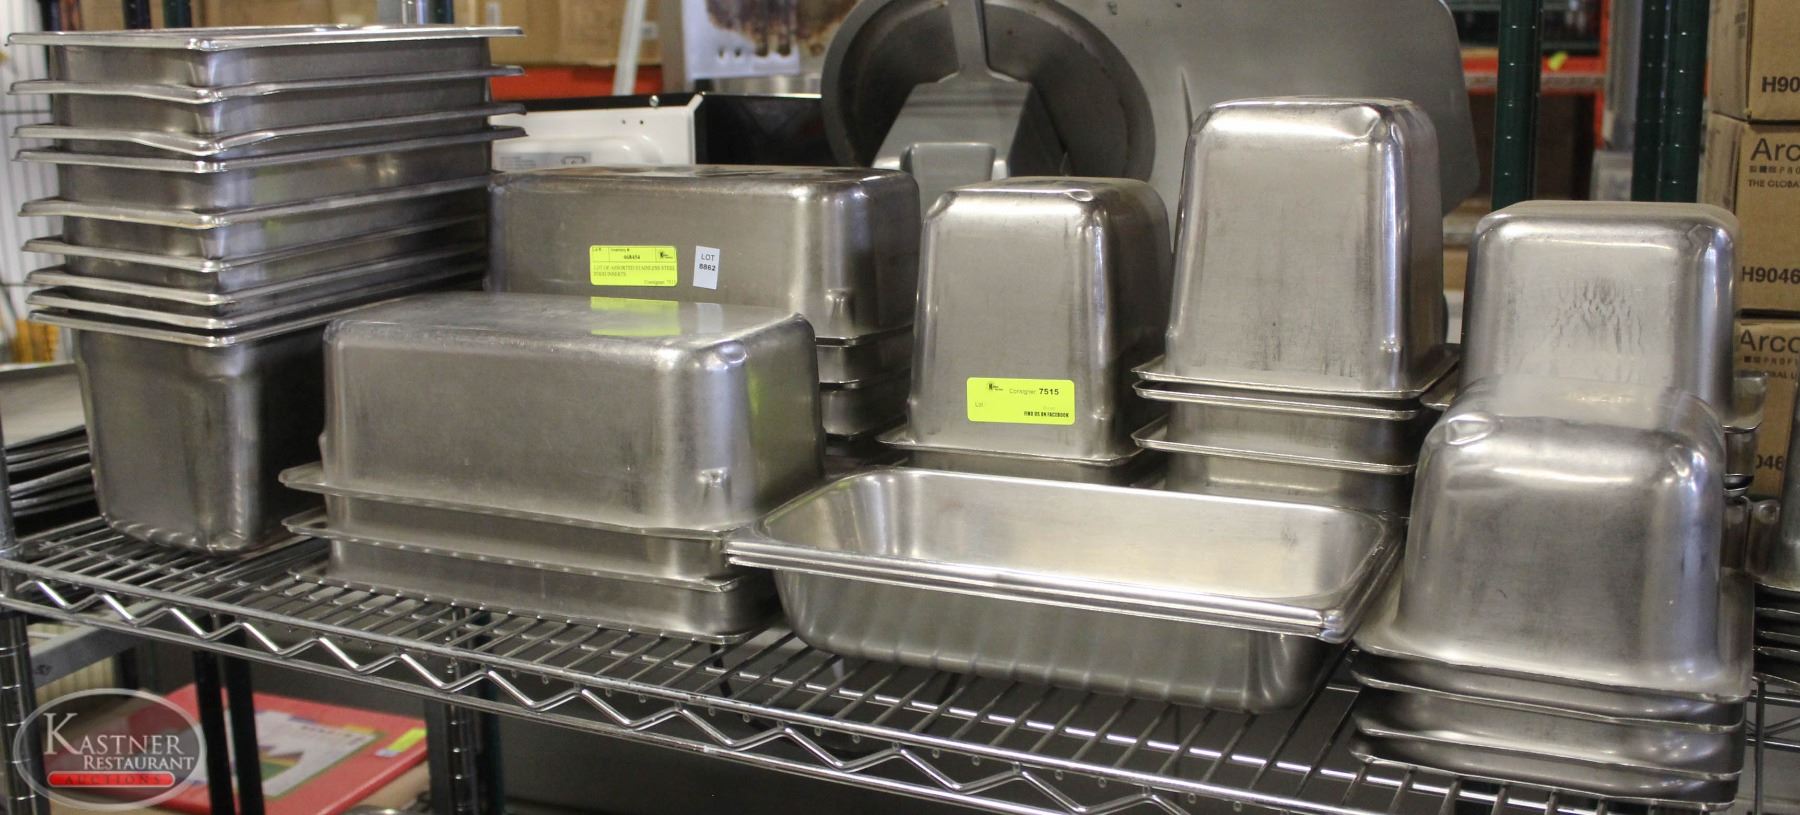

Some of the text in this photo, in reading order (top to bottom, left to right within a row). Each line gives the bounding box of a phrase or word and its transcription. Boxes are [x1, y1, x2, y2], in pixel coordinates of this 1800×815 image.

[1748, 179, 1765, 188] THE
[700, 253, 715, 261] LOT
[1742, 266, 1800, 285] H9046
